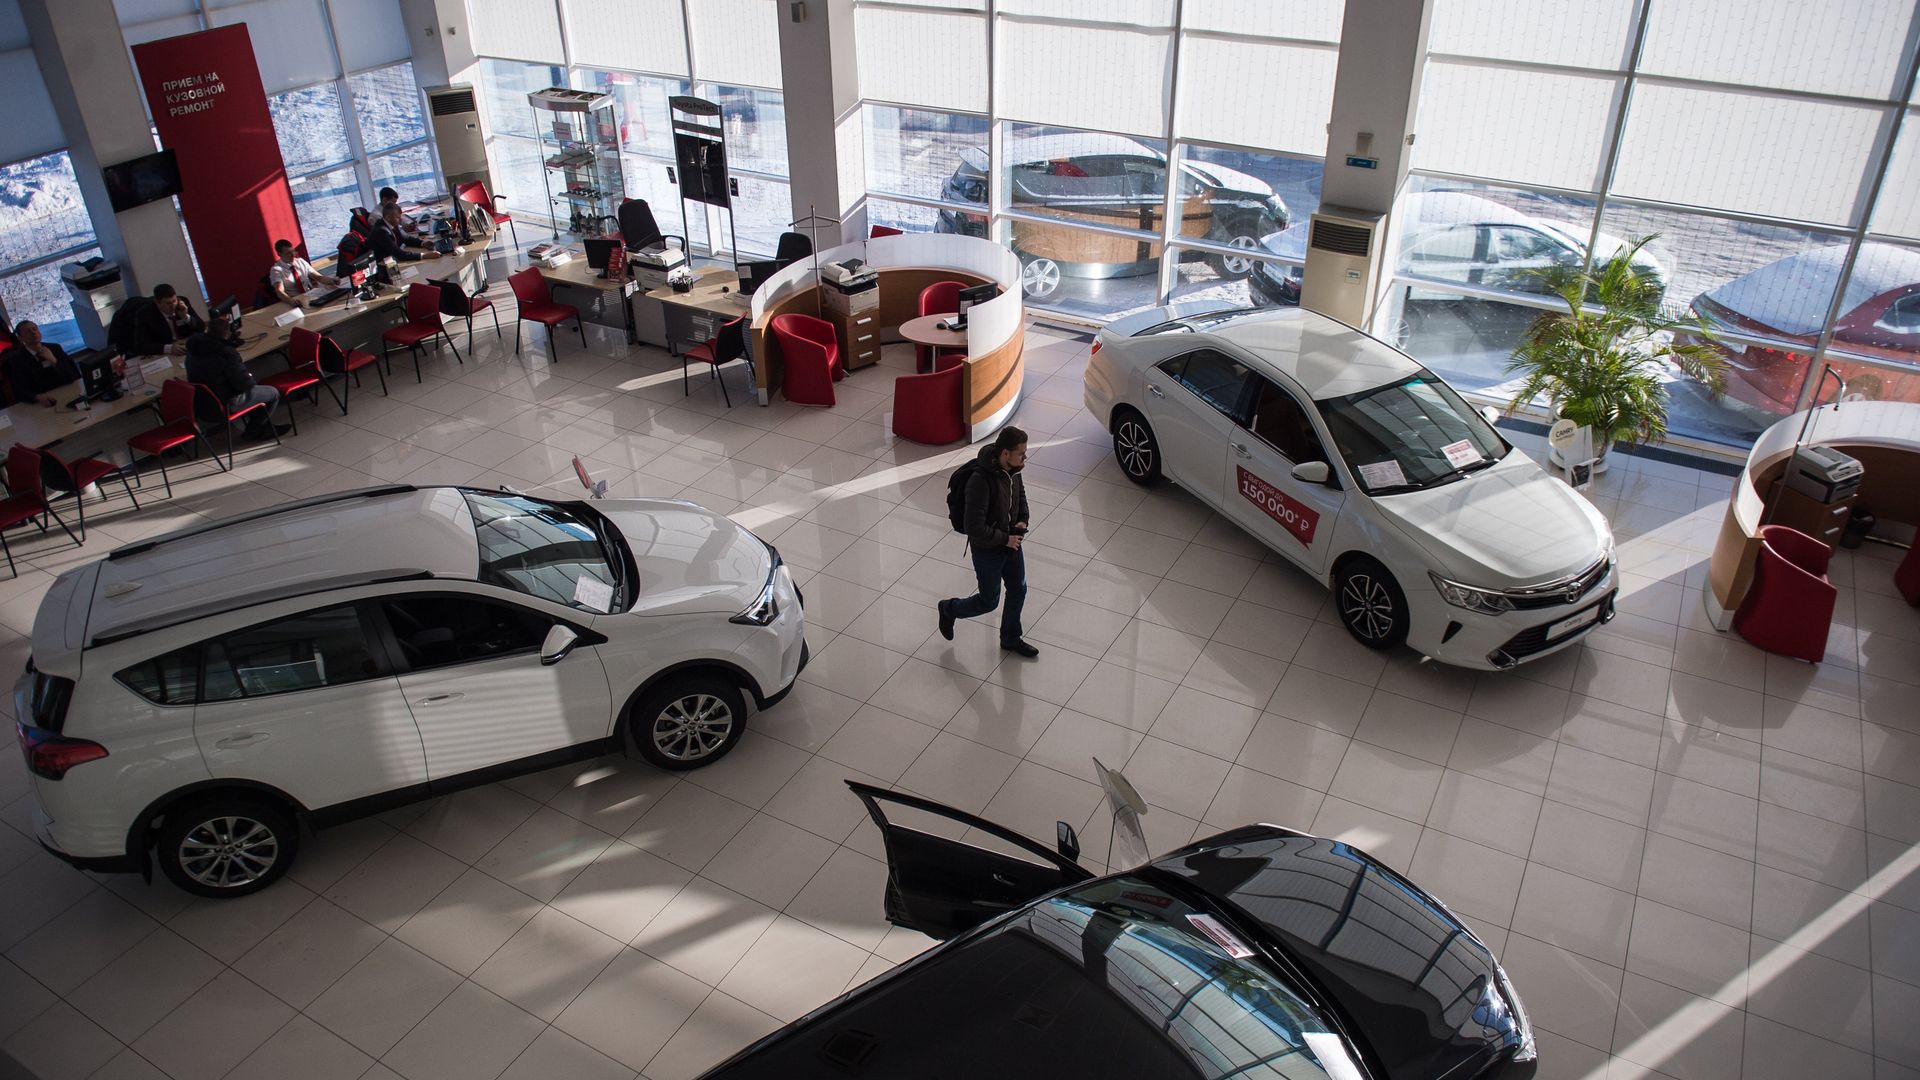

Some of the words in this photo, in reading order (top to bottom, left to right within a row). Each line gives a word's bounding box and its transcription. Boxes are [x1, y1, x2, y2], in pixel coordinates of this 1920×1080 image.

[162, 75, 202, 91] ПРИЕМ
[204, 72, 220, 83] НА
[166, 81, 225, 104] КУЗОВНОЙ
[170, 99, 215, 117] РЕМОНТ
[1555, 427, 1574, 438] CAMRY
[1242, 480, 1266, 504] 150
